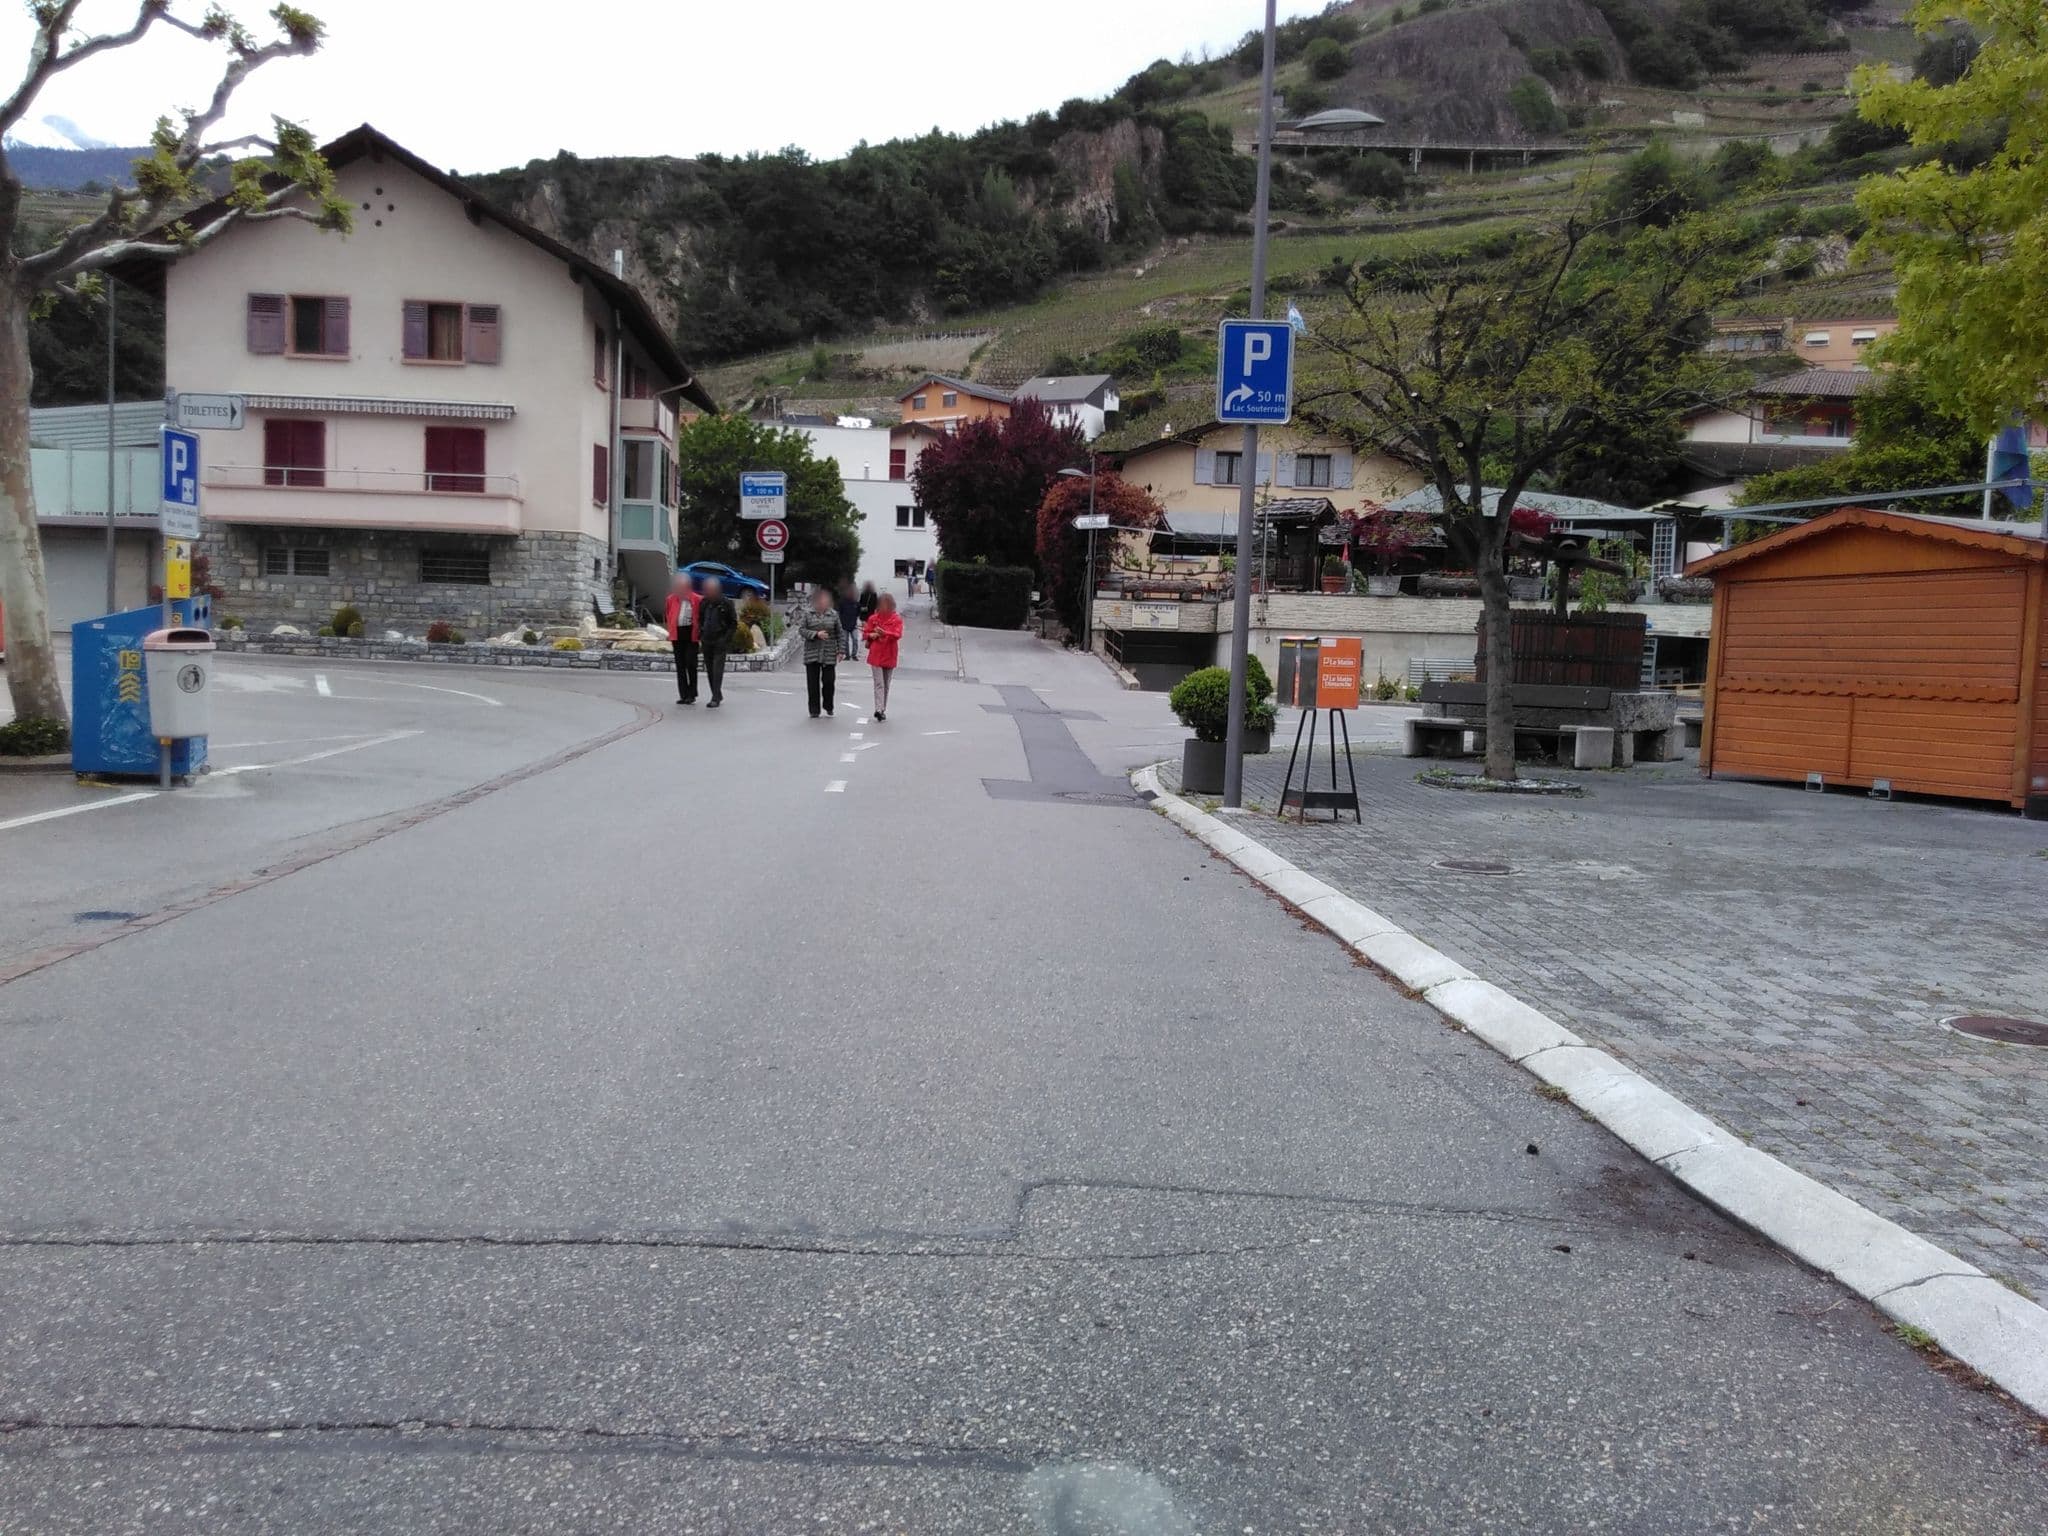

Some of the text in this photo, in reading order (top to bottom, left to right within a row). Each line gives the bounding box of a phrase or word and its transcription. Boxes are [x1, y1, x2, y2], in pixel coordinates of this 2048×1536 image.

[1243, 332, 1272, 377] P
[1257, 391, 1285, 402] 50 m
[183, 405, 229, 417] TOILETTES
[1232, 404, 1285, 413] Lac Souterrain
[171, 439, 188, 486] P
